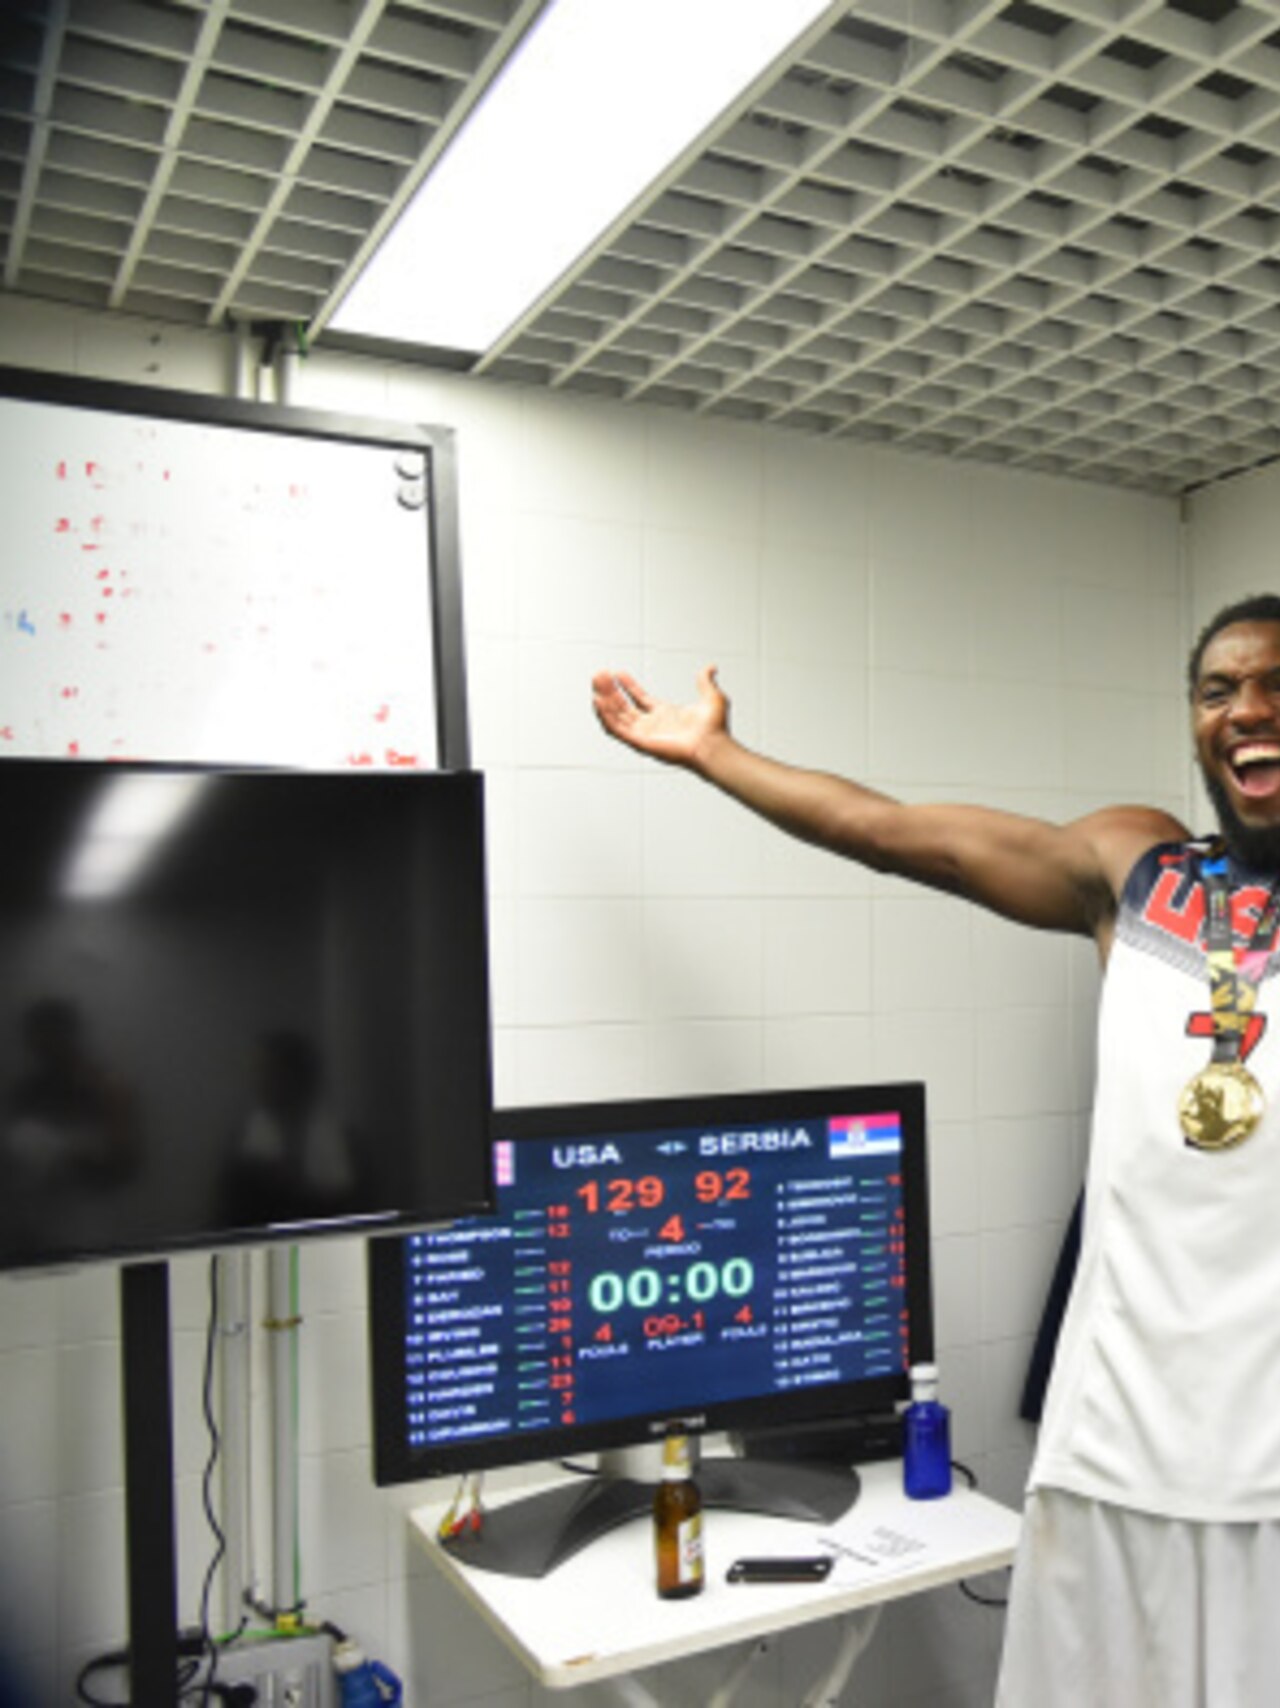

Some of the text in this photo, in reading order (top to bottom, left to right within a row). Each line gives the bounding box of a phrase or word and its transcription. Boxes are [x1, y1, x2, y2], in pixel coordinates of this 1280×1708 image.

[552, 1142, 622, 1168] USA
[699, 1128, 812, 1156] SERBIA
[577, 1175, 664, 1213] 129
[695, 1166, 751, 1203] 92
[657, 1214, 685, 1242] 4
[589, 1257, 755, 1313] 00:00
[593, 1321, 613, 1343] 4
[734, 1303, 753, 1324] 4
